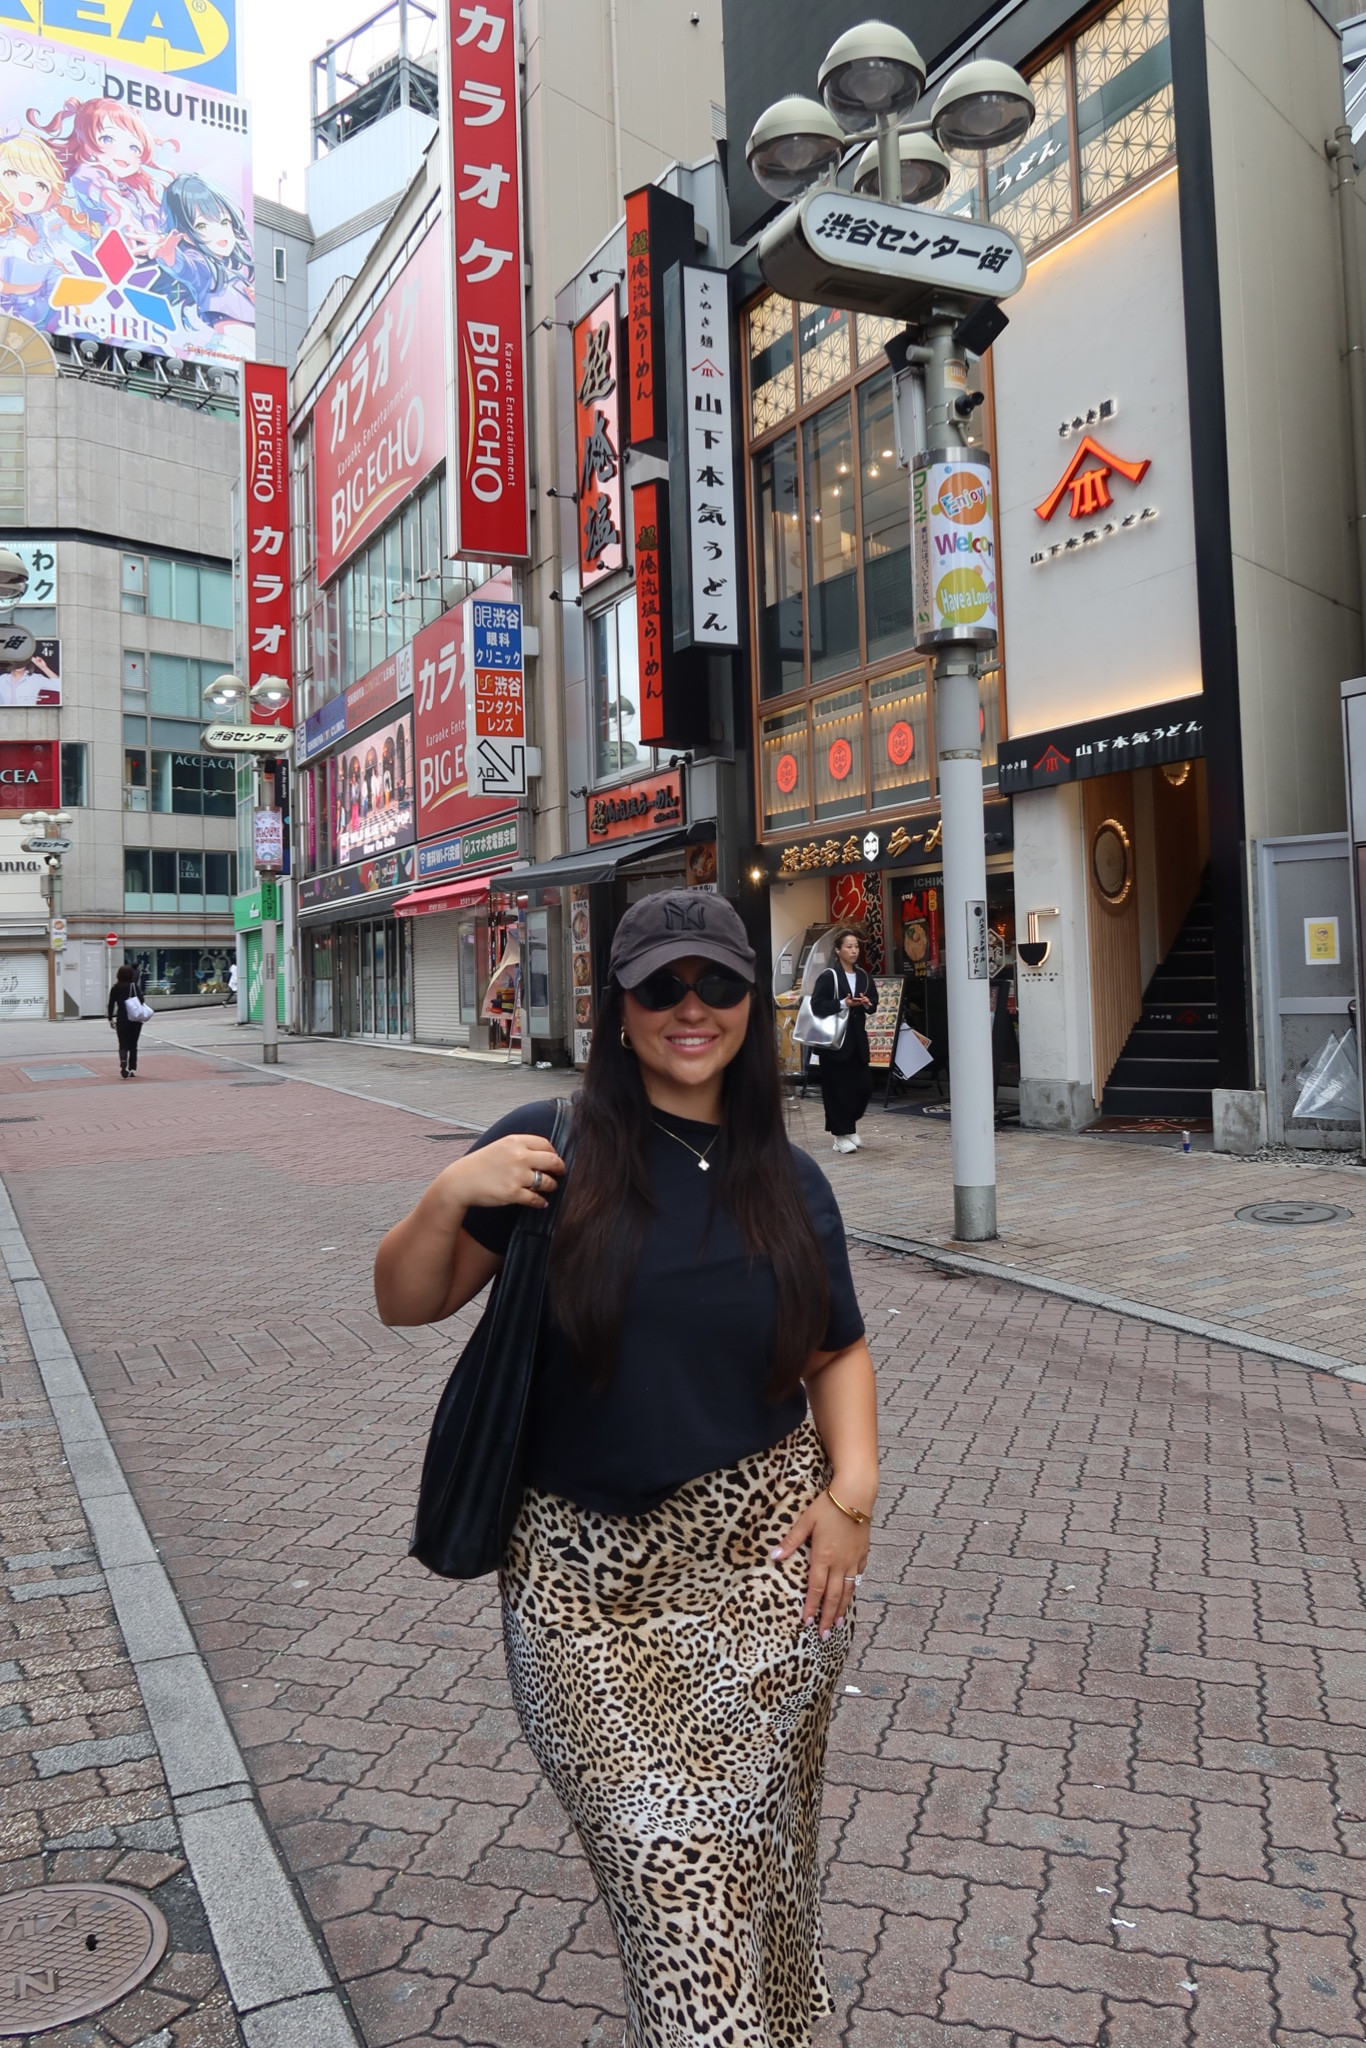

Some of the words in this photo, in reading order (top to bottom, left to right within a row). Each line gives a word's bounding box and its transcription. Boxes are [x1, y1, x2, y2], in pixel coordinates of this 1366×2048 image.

[456, 4, 513, 284] カラオケ
[995, 138, 1062, 196] うどん
[815, 210, 1015, 275] 渋谷センター街
[60, 305, 168, 346] Re:IRIS
[699, 282, 713, 349] さぬき麺
[330, 275, 421, 455] カラオケ
[465, 320, 500, 391] BIG
[504, 342, 513, 391] Karaoke
[251, 392, 274, 436] BIG
[470, 399, 503, 503] ECHO
[505, 394, 516, 487] Entertainment
[252, 439, 275, 503] ECHO
[331, 467, 365, 557] BIG
[366, 395, 425, 494] ECHO
[694, 393, 728, 631] 山下本気うどん
[912, 470, 928, 524] Don't
[940, 486, 985, 517] Enjoy
[1030, 507, 1157, 564] 山下本気うどん
[492, 607, 520, 630] 渋谷
[941, 588, 965, 614] Have
[965, 592, 972, 607] a
[476, 648, 521, 666] クリニック
[486, 632, 510, 648] 眼科
[476, 699, 522, 716] コンタクト
[494, 675, 522, 698] 渋谷
[209, 730, 289, 744] 渋谷センター街
[425, 725, 450, 748] Karaoke
[487, 717, 514, 733] レンズ
[1075, 720, 1203, 757] 山下本気うどん
[0, 769, 39, 784] CEA
[420, 749, 452, 809] BIG
[477, 766, 495, 779] 入口
